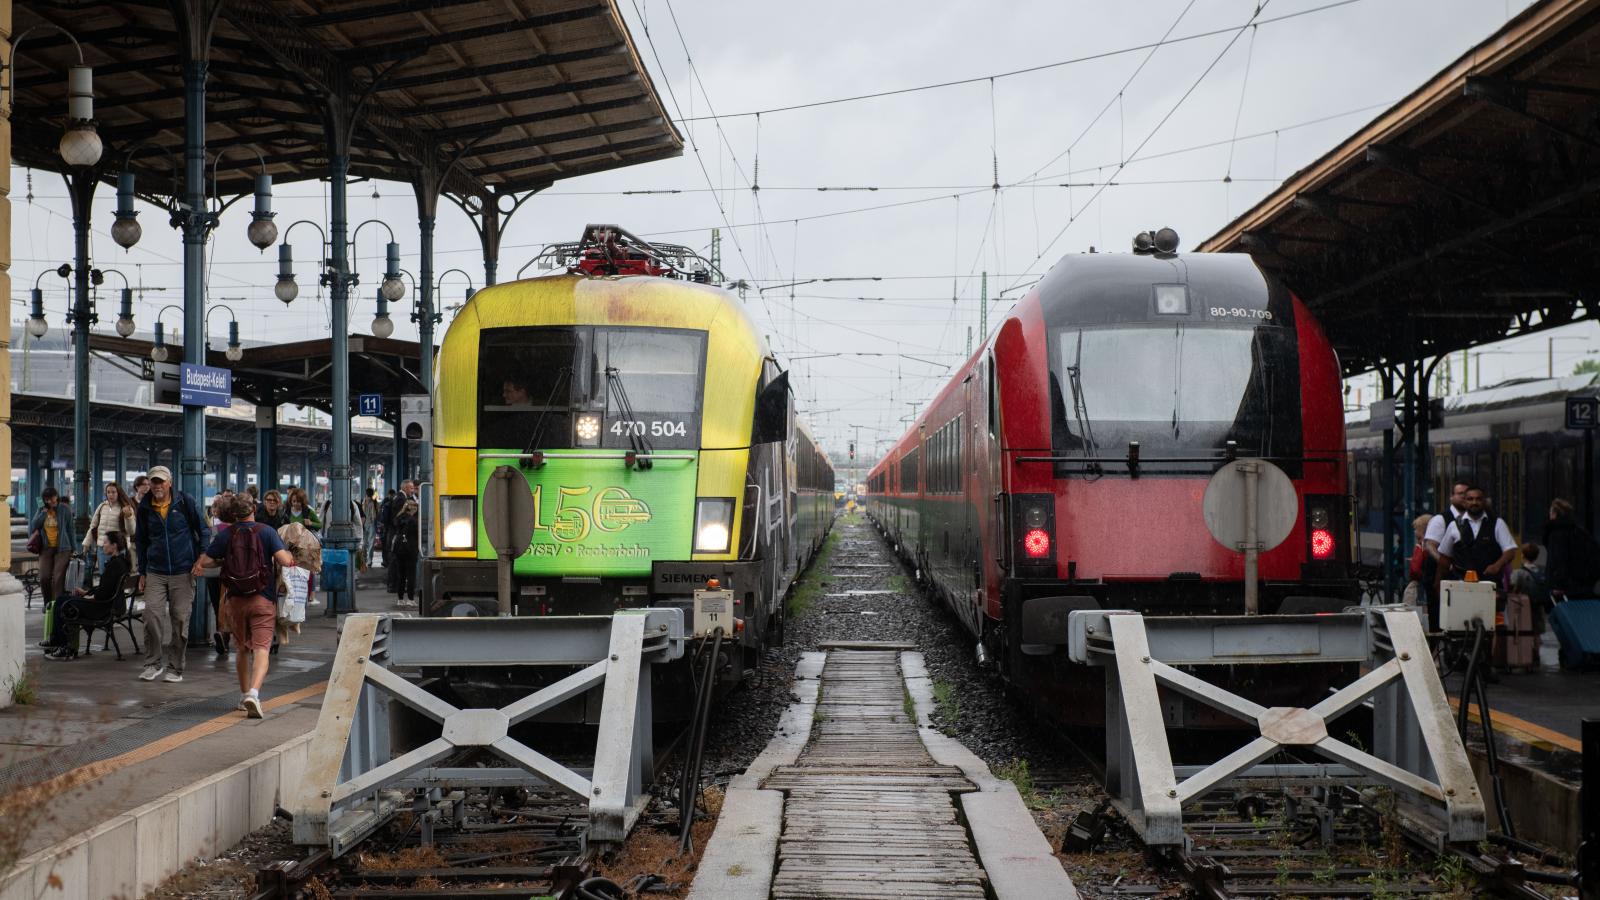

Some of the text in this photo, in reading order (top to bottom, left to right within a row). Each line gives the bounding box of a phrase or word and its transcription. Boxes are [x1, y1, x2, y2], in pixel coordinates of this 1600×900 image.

[1210, 307, 1273, 320] 80-90.709
[186, 368, 227, 391] Budapest-Keleti
[364, 397, 377, 410] 11
[1572, 403, 1591, 419] 12
[610, 420, 687, 437] 470 504
[575, 543, 650, 557] Raaberbahn
[709, 613, 718, 622] 11
